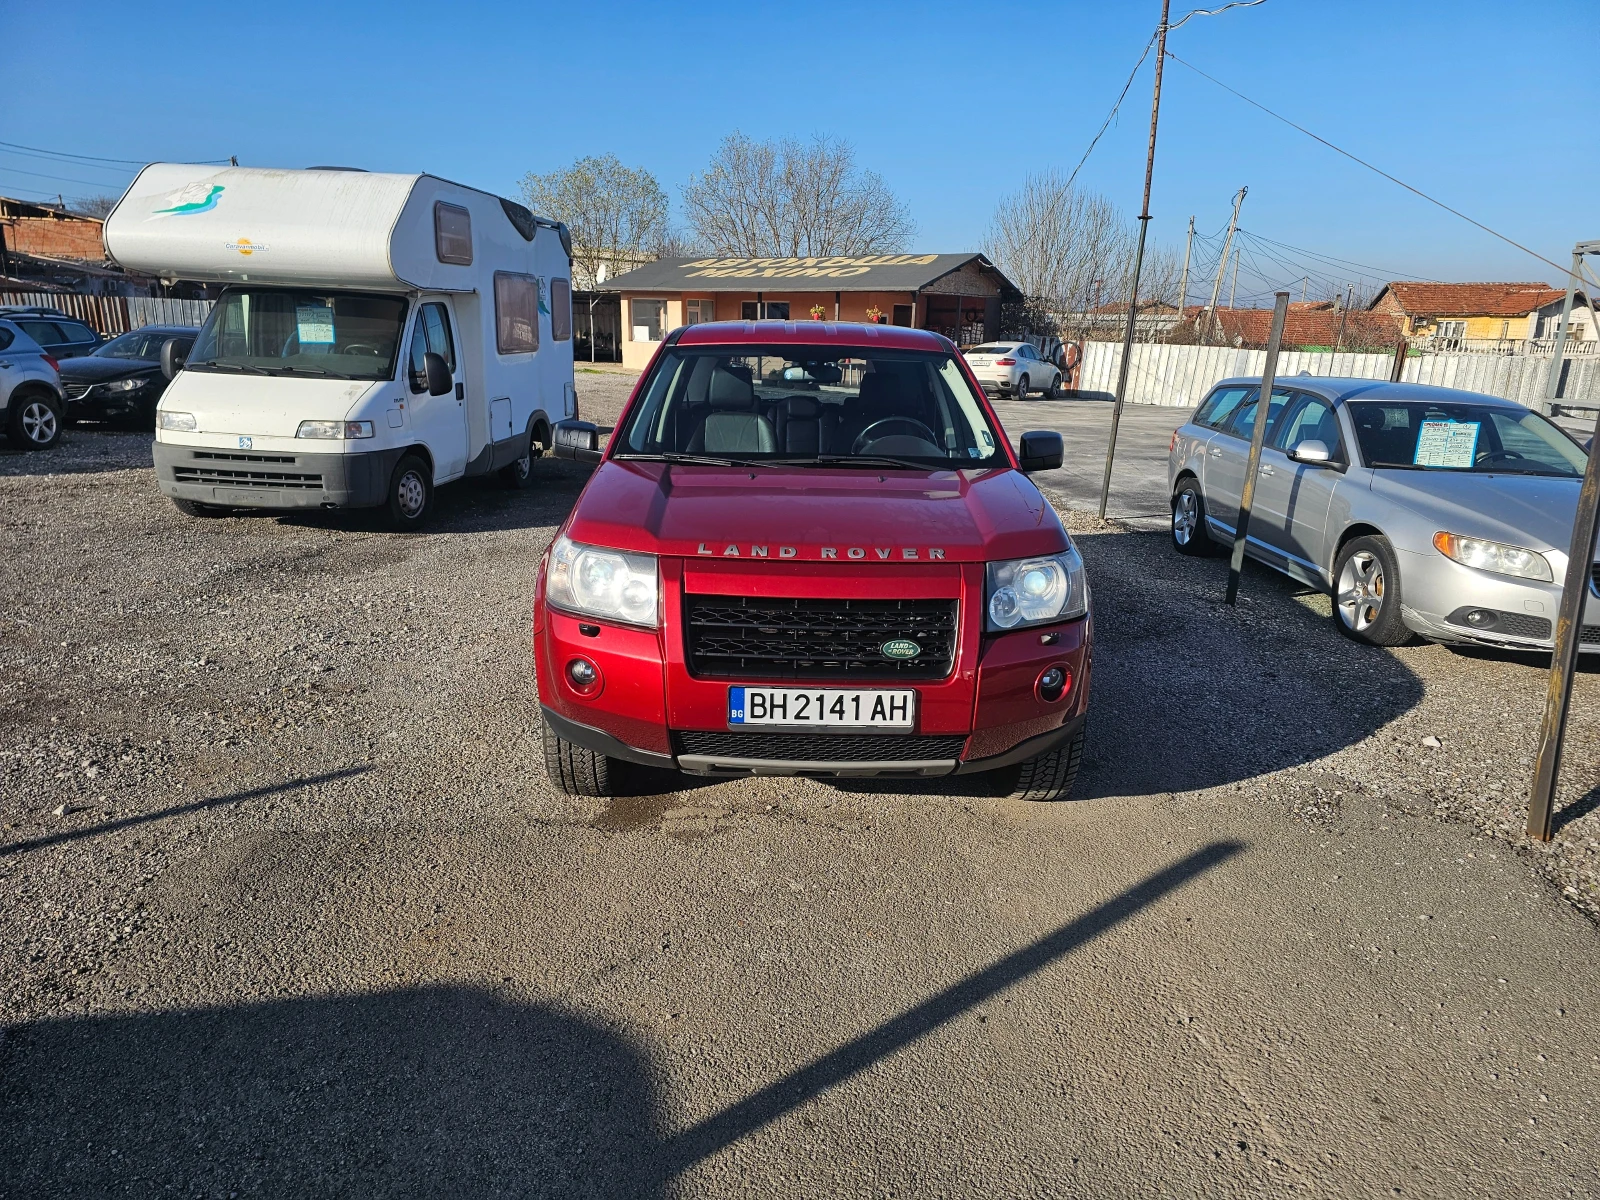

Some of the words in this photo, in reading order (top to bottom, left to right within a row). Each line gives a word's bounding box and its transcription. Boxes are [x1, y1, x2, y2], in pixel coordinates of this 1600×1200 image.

[684, 266, 872, 278] MAXIMO
[697, 543, 798, 558] LAND
[820, 547, 946, 560] ROVER
[731, 709, 744, 718] BG
[870, 694, 908, 722] AH
